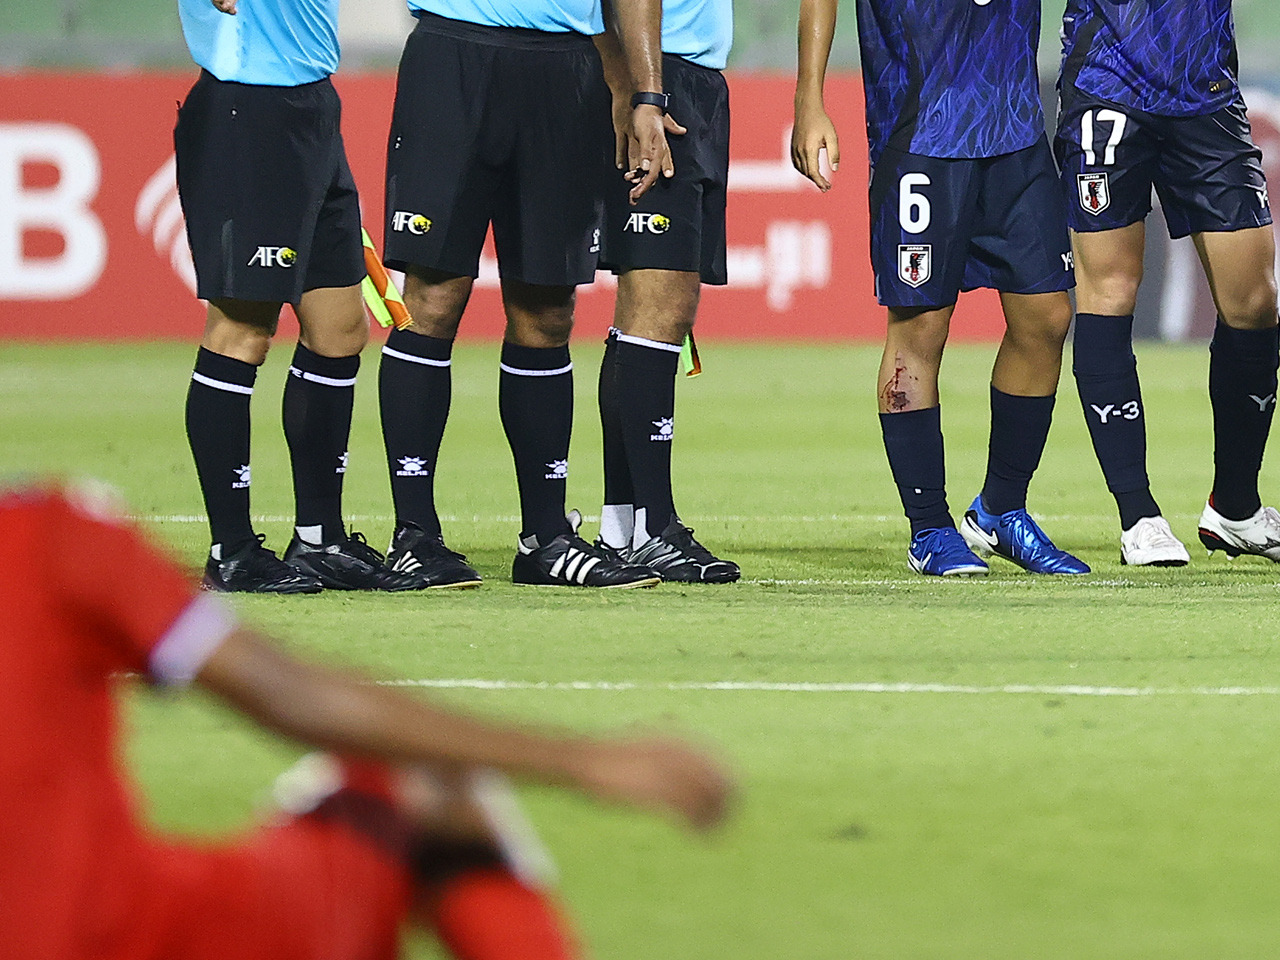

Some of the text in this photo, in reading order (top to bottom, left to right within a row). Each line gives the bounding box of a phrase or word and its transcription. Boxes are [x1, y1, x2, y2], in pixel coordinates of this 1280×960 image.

[1081, 109, 1127, 166] 17
[899, 172, 931, 234] 6
[623, 212, 671, 234] AFC
[247, 246, 298, 268] AFC
[1091, 400, 1140, 423] Y-3
